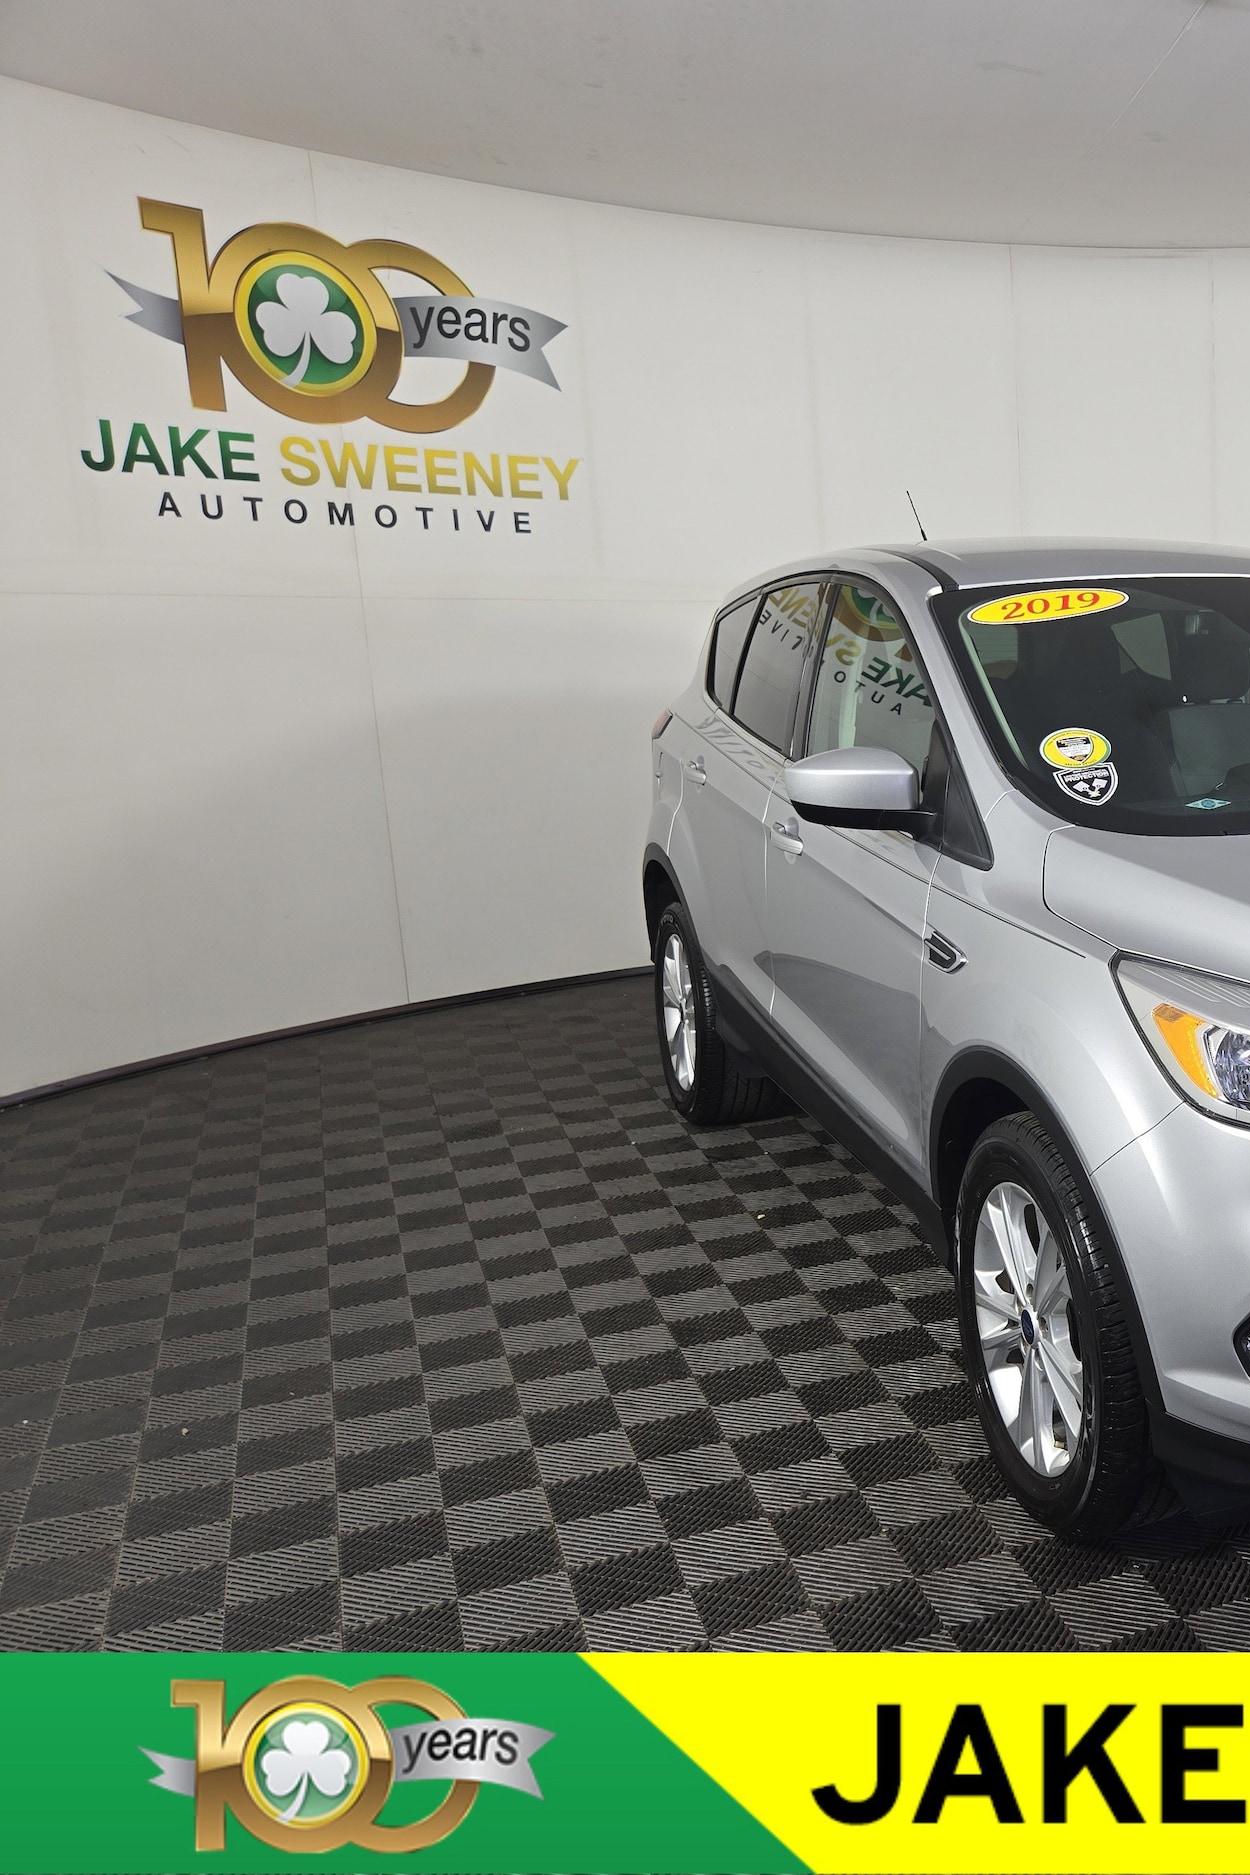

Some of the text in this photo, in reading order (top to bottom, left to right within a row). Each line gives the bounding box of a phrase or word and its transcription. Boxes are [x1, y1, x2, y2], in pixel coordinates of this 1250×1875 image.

[409, 304, 532, 352] years
[80, 419, 580, 500] JAKE SWEENEY
[157, 491, 533, 534] AUTOMOTIVE
[1001, 591, 1101, 621] 2019
